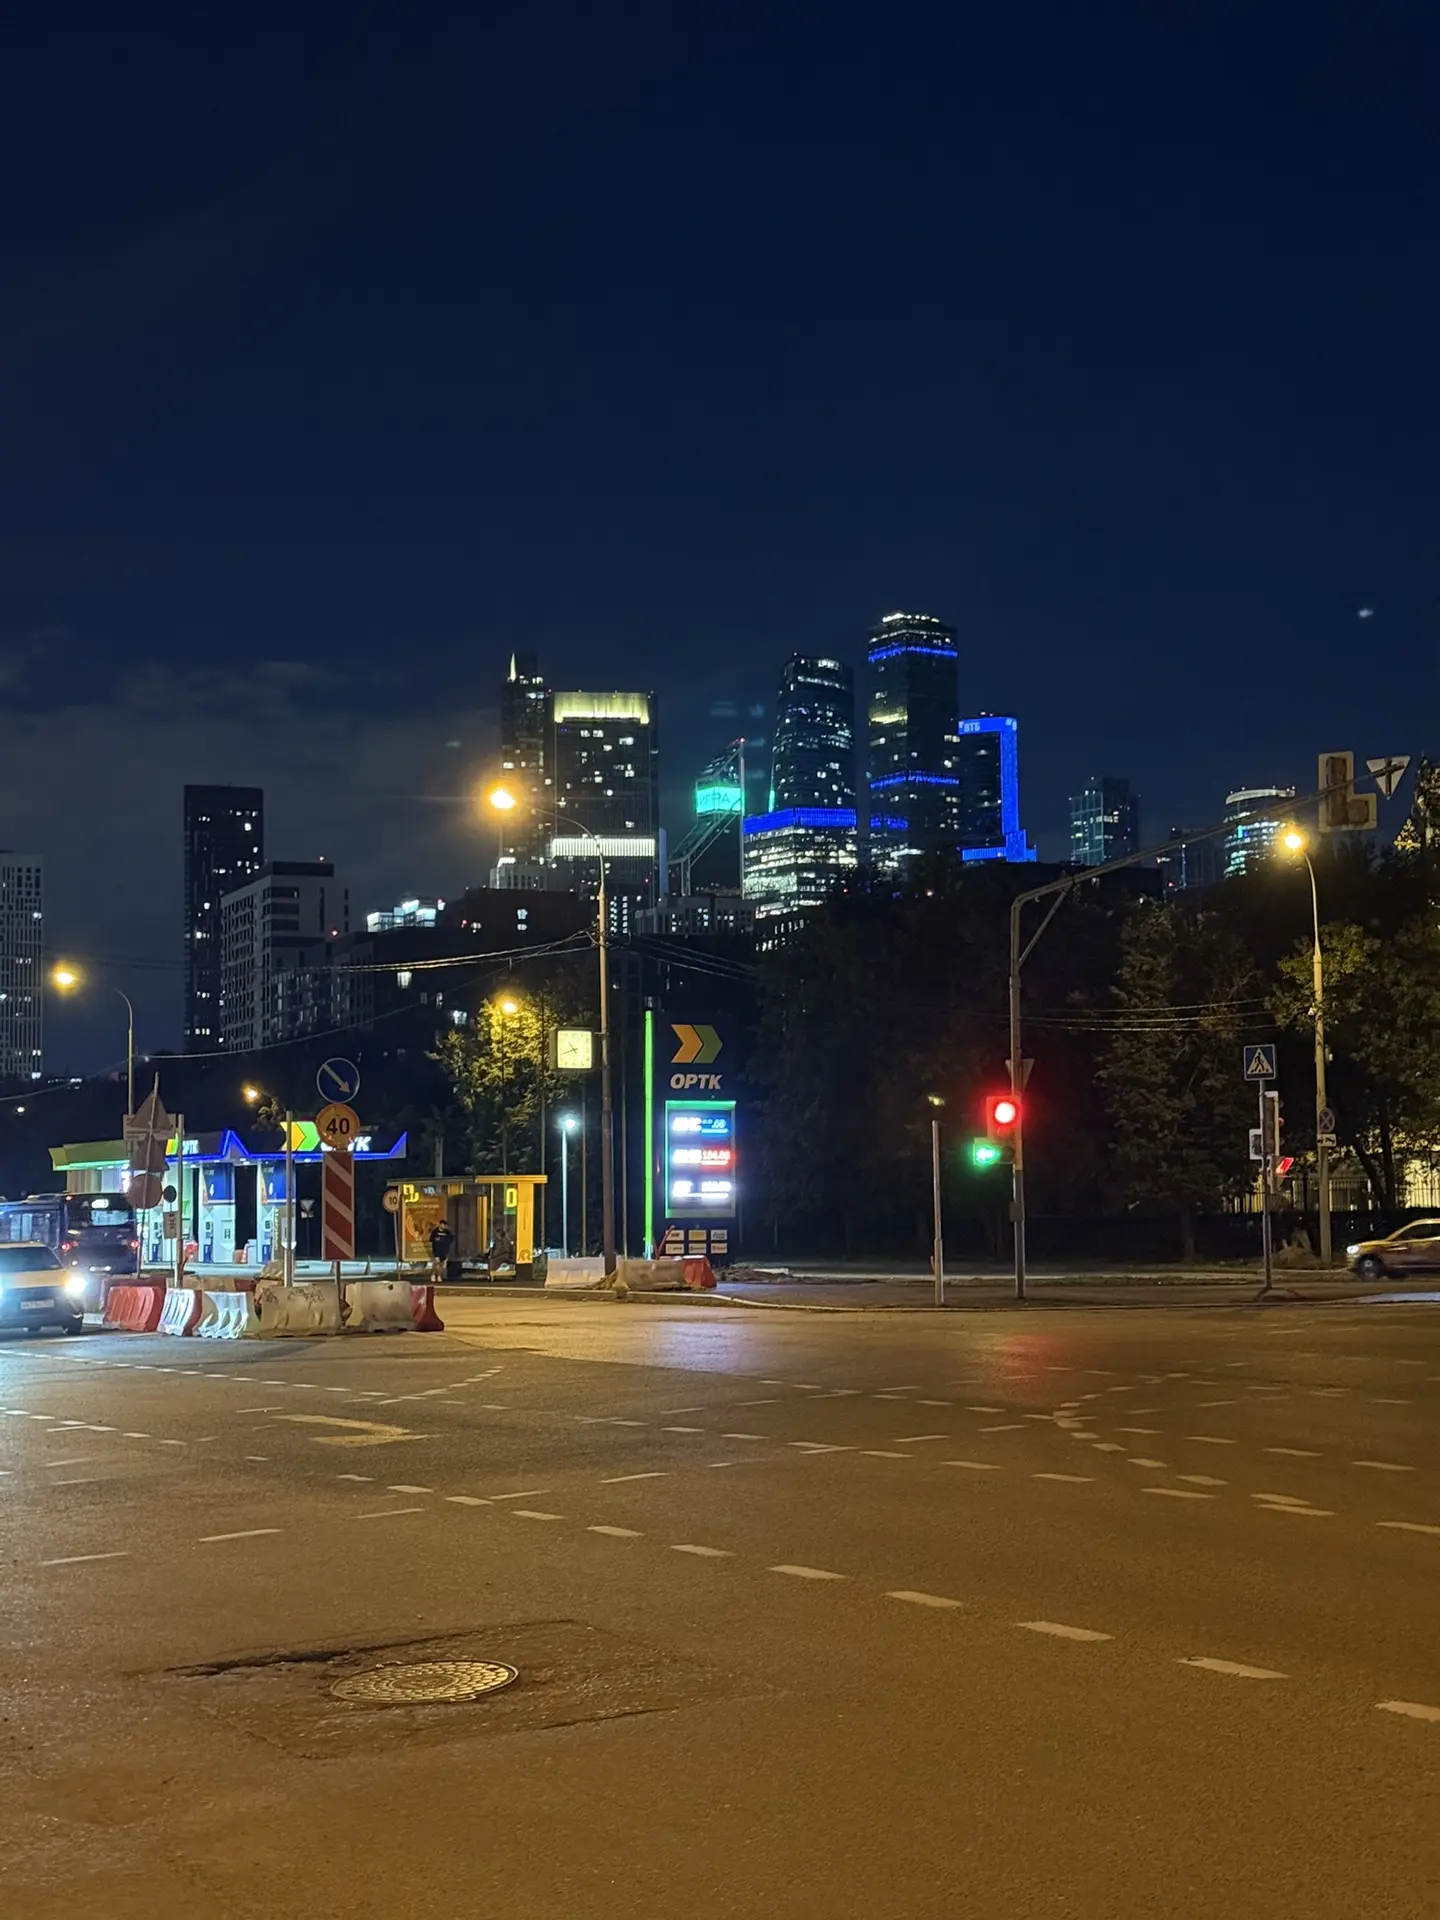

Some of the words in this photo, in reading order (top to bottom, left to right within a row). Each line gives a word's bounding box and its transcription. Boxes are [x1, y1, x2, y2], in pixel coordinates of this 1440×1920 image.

[670, 1073, 723, 1090] ОРТК
[326, 1118, 350, 1135] 40
[389, 1197, 398, 1205] 10
